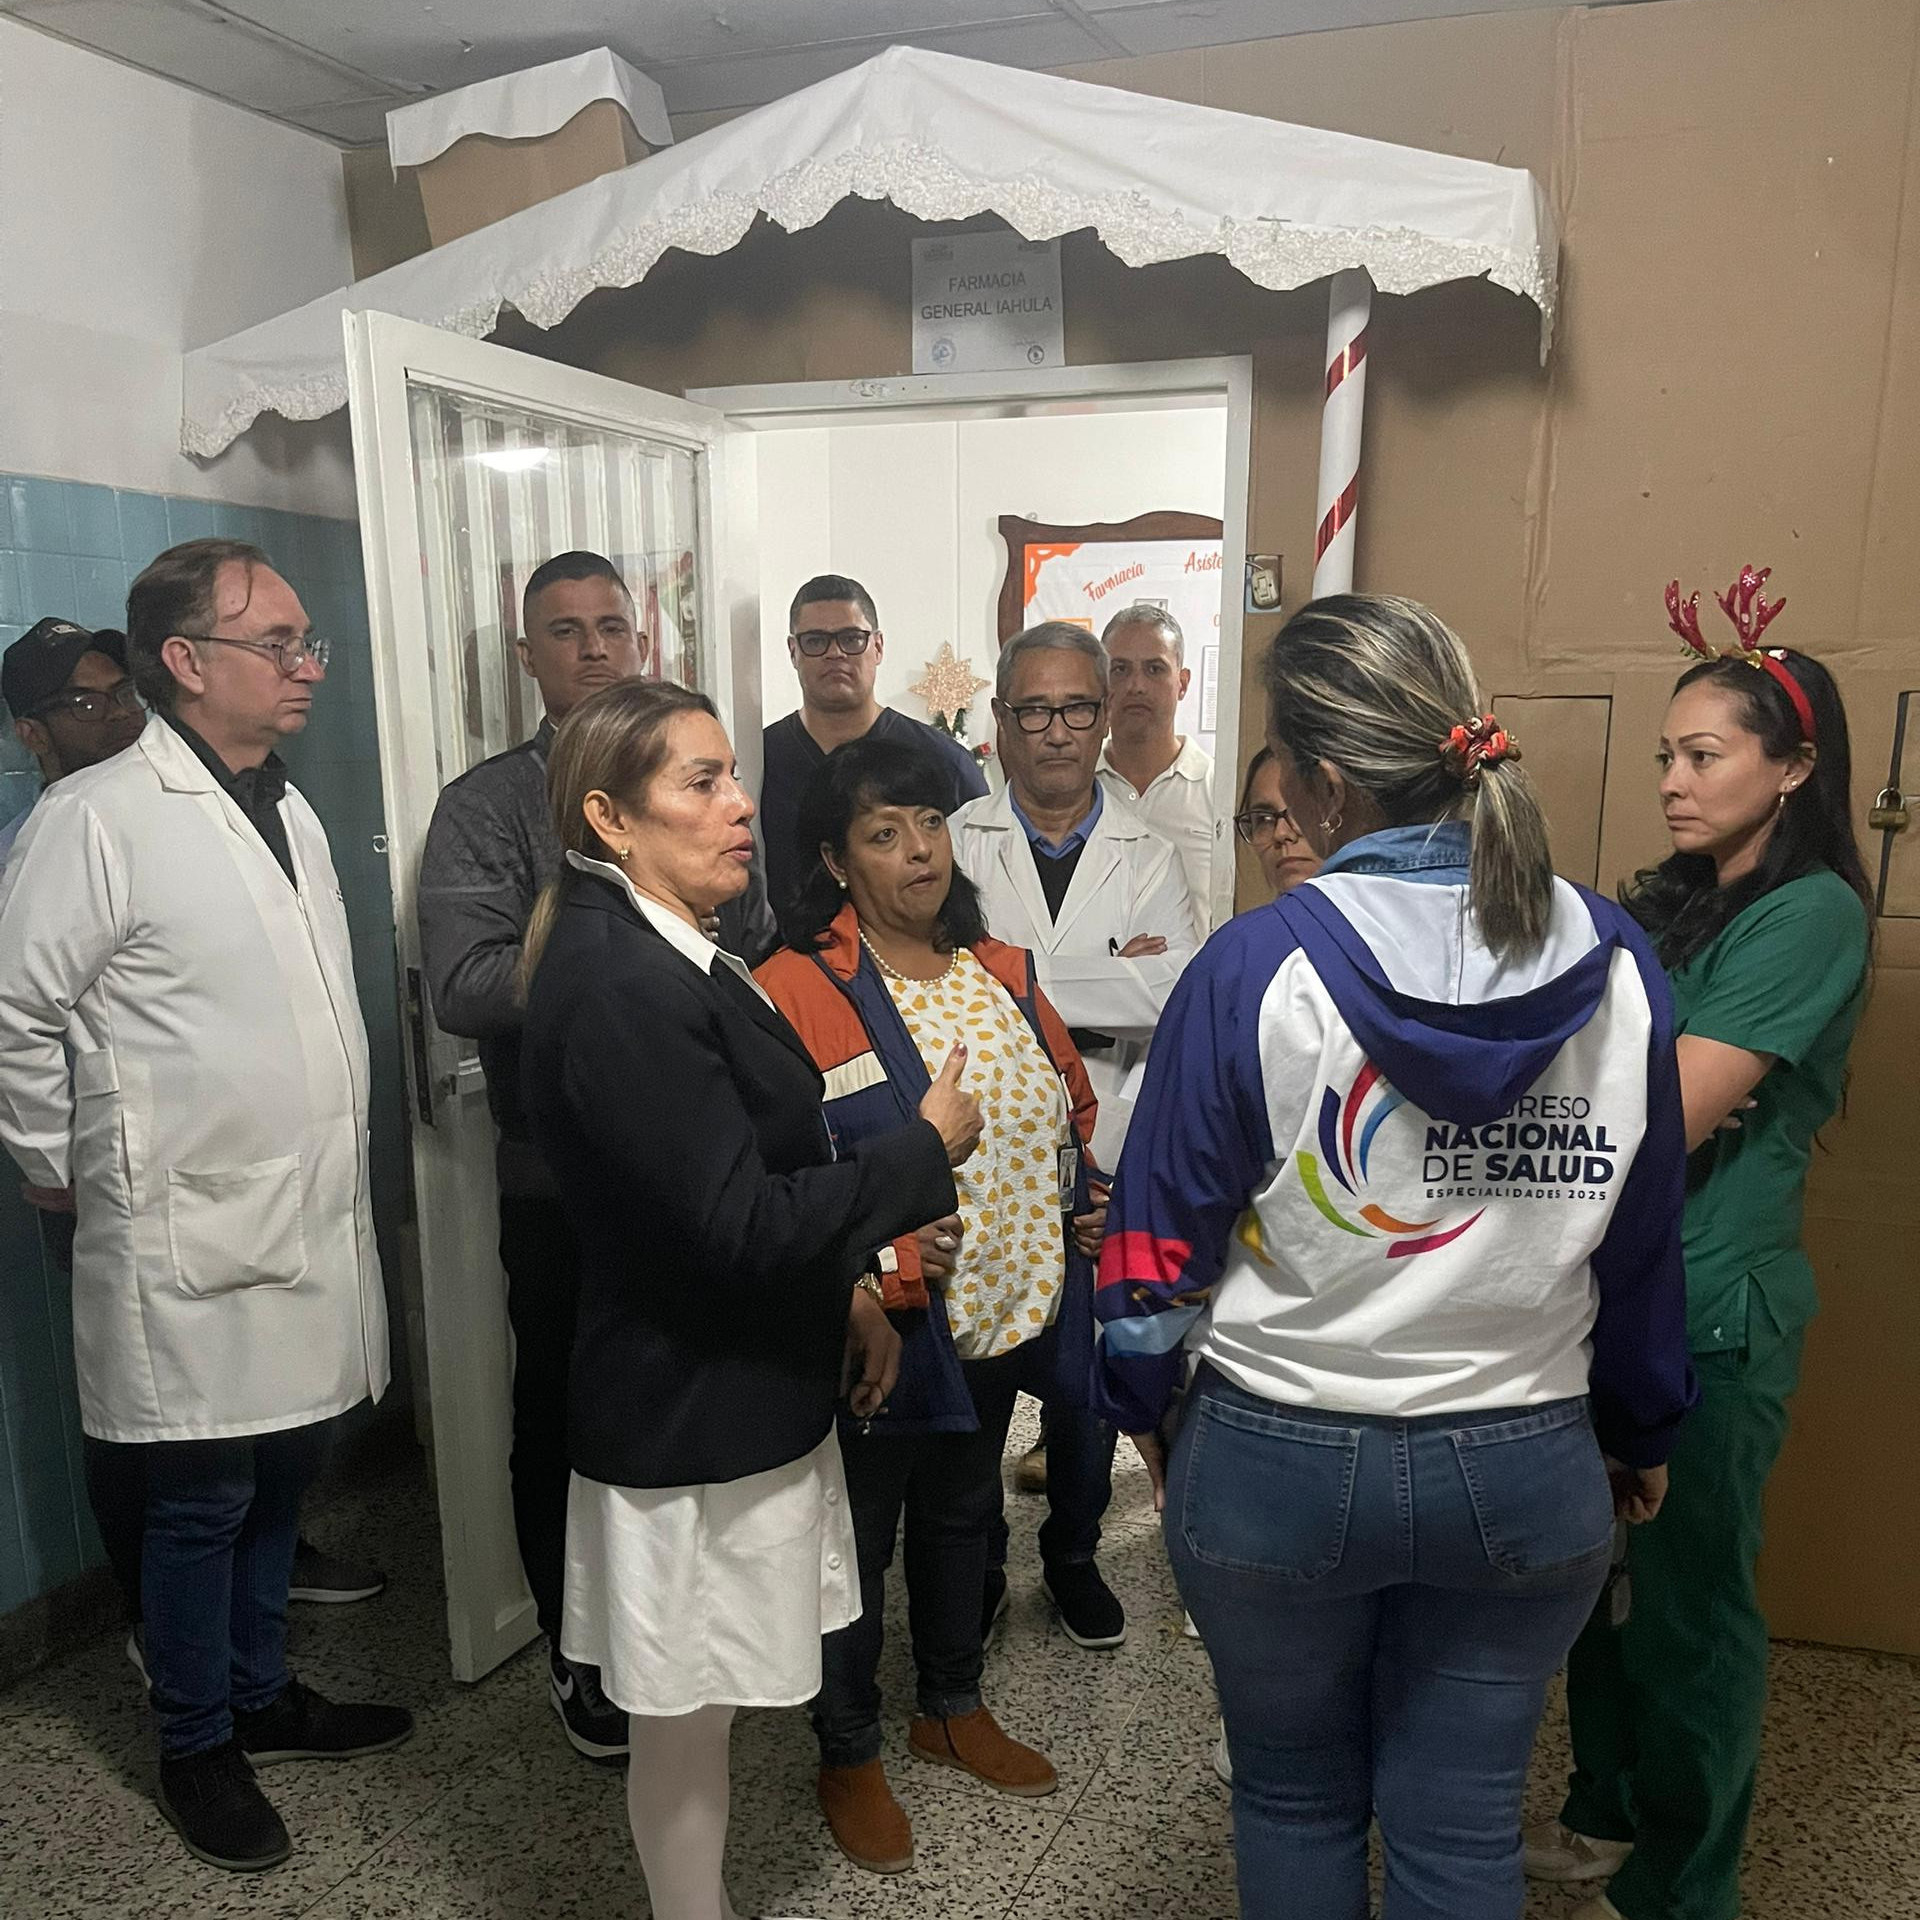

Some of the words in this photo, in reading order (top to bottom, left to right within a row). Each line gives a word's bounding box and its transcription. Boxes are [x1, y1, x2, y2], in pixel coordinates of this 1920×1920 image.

[949, 272, 1026, 292] FARMACIA
[921, 302, 992, 320] GENERAL
[996, 297, 1053, 314] IAHULA
[1083, 561, 1145, 602] Farmacia
[1506, 1095, 1590, 1119] RESO
[1425, 1122, 1617, 1153] NACIONAL
[1423, 1154, 1474, 1183] DE
[1485, 1154, 1614, 1184] SALUD
[1426, 1187, 1561, 1199] ESPECIALIDADES
[1568, 1189, 1607, 1200] 2025
